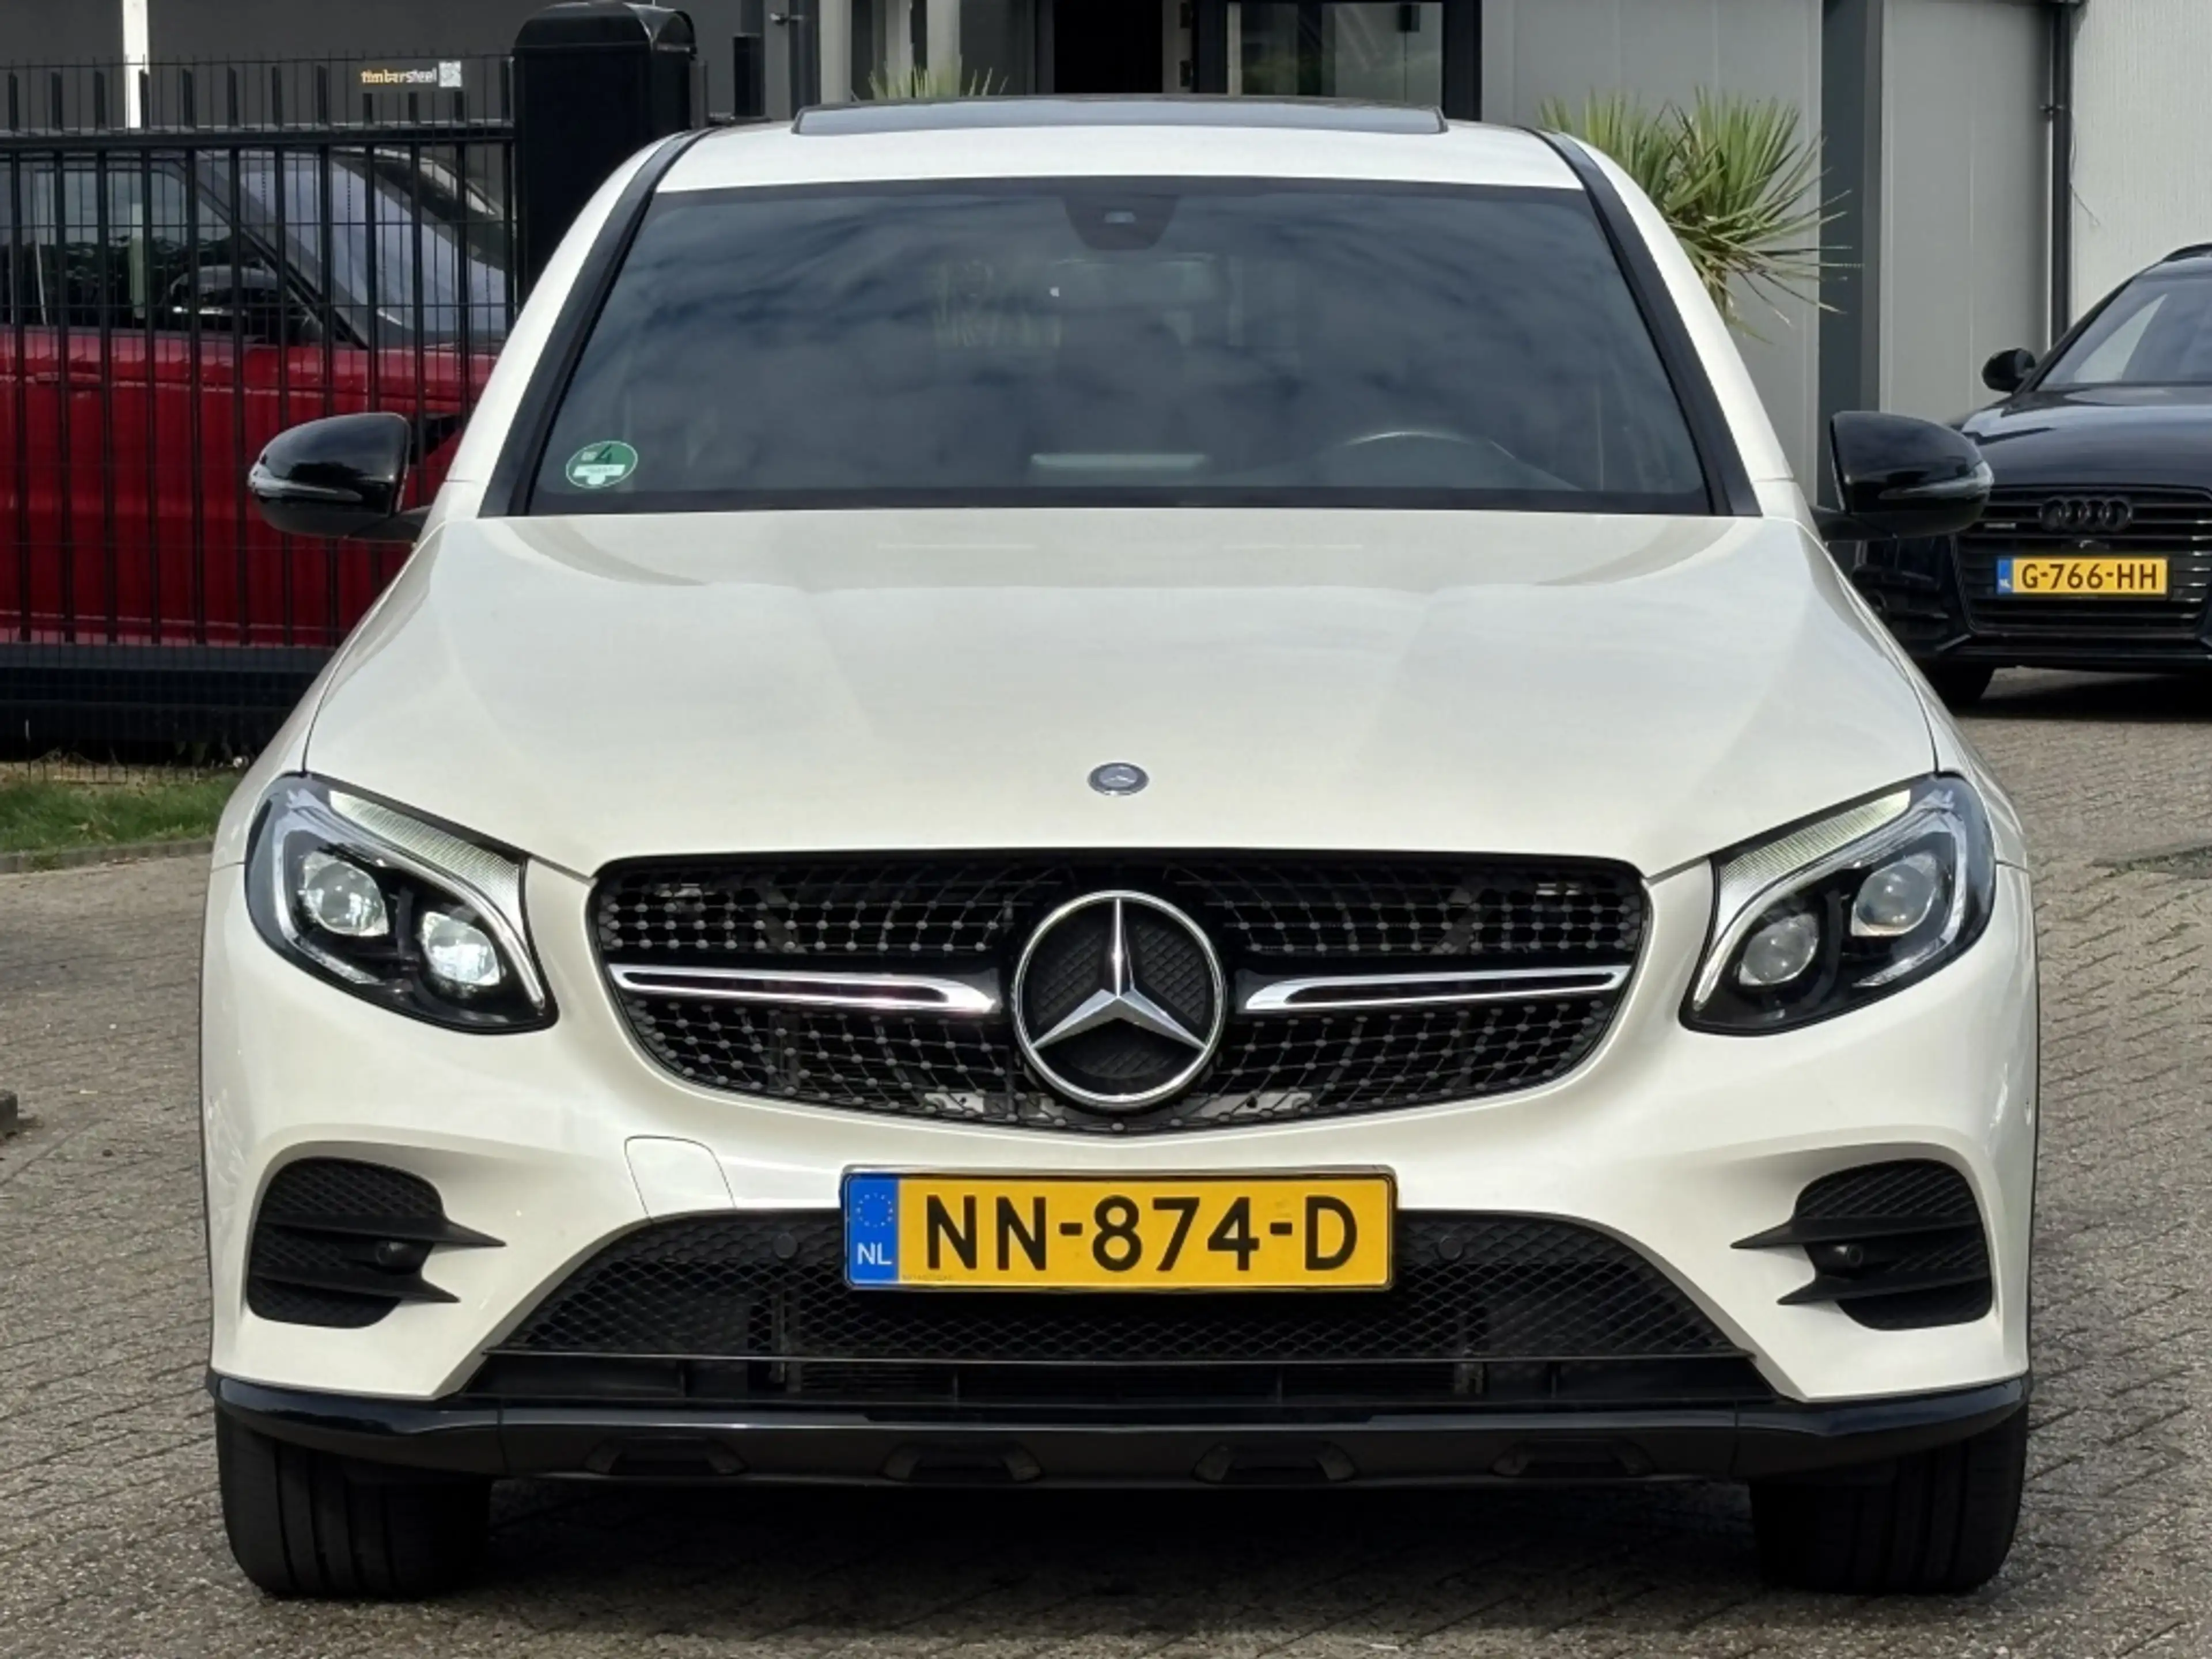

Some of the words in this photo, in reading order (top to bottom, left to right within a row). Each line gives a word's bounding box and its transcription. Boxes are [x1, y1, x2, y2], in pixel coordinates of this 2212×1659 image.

[361, 67, 437, 84] timbersteel
[2021, 563, 2157, 589] G-766-HH
[926, 1195, 1358, 1272] NN-874-D
[857, 1242, 892, 1265] NL
